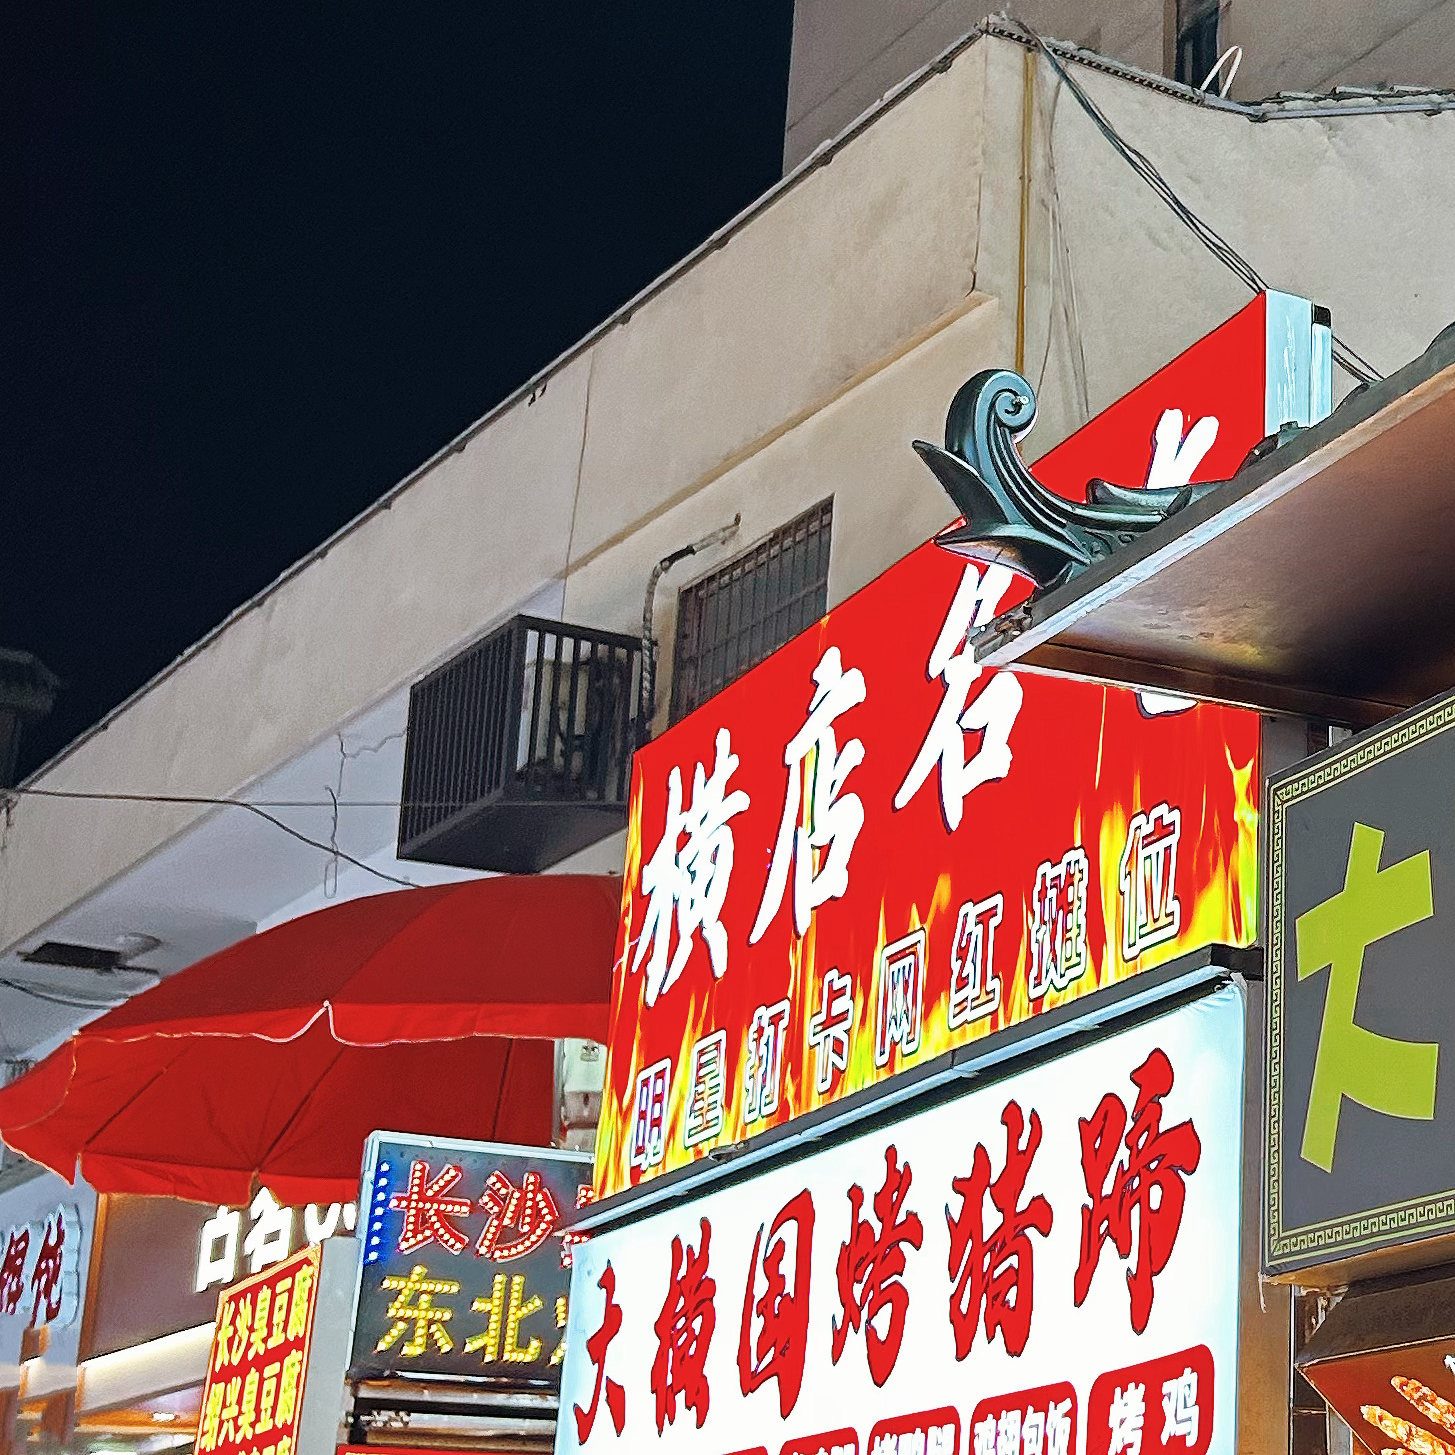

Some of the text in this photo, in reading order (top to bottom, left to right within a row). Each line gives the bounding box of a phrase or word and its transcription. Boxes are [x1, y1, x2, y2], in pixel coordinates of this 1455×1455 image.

[631, 408, 1219, 1007] 横店名
[630, 801, 1182, 1170] 明星打卡网红摊位
[389, 1160, 593, 1269] 长沙
[573, 1048, 1202, 1446] 大横国烤猪蹄
[215, 1264, 314, 1373] 长沙臭豆腐
[374, 1264, 569, 1368] 东北
[201, 1349, 303, 1452] 绍兴臭豆腐
[1108, 1367, 1199, 1455] 烤鸡
